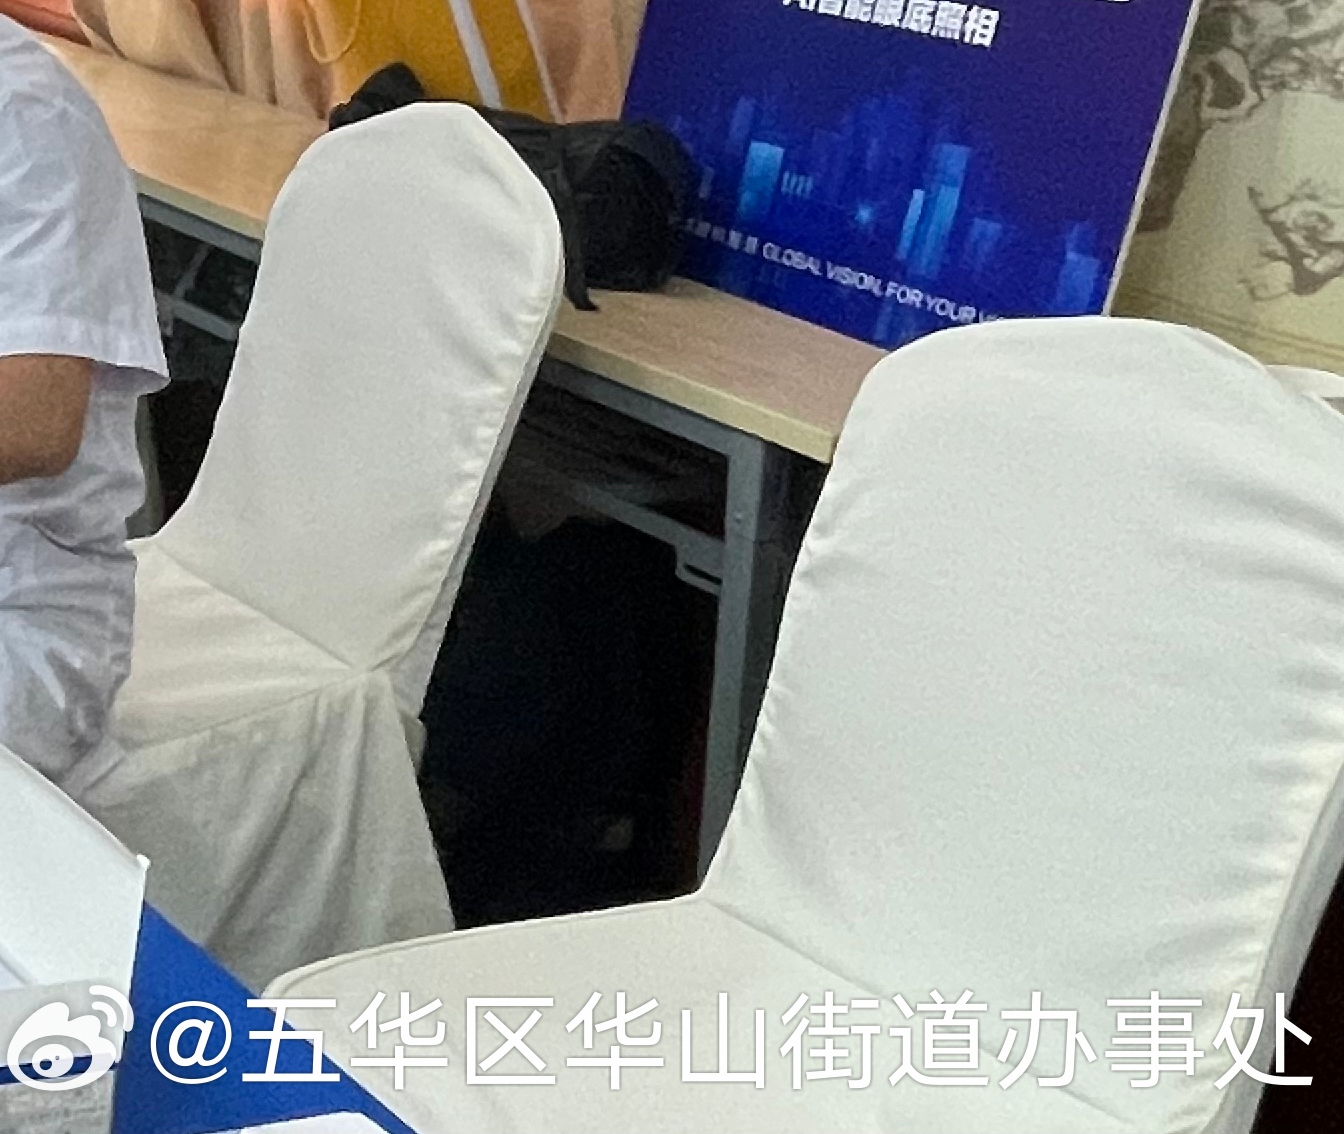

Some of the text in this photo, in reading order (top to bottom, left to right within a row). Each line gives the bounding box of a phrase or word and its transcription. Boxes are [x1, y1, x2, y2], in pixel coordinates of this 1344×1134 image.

[762, 241, 823, 277] GLOBAL
[885, 280, 924, 309] FOR
[925, 297, 977, 324] YOUR
